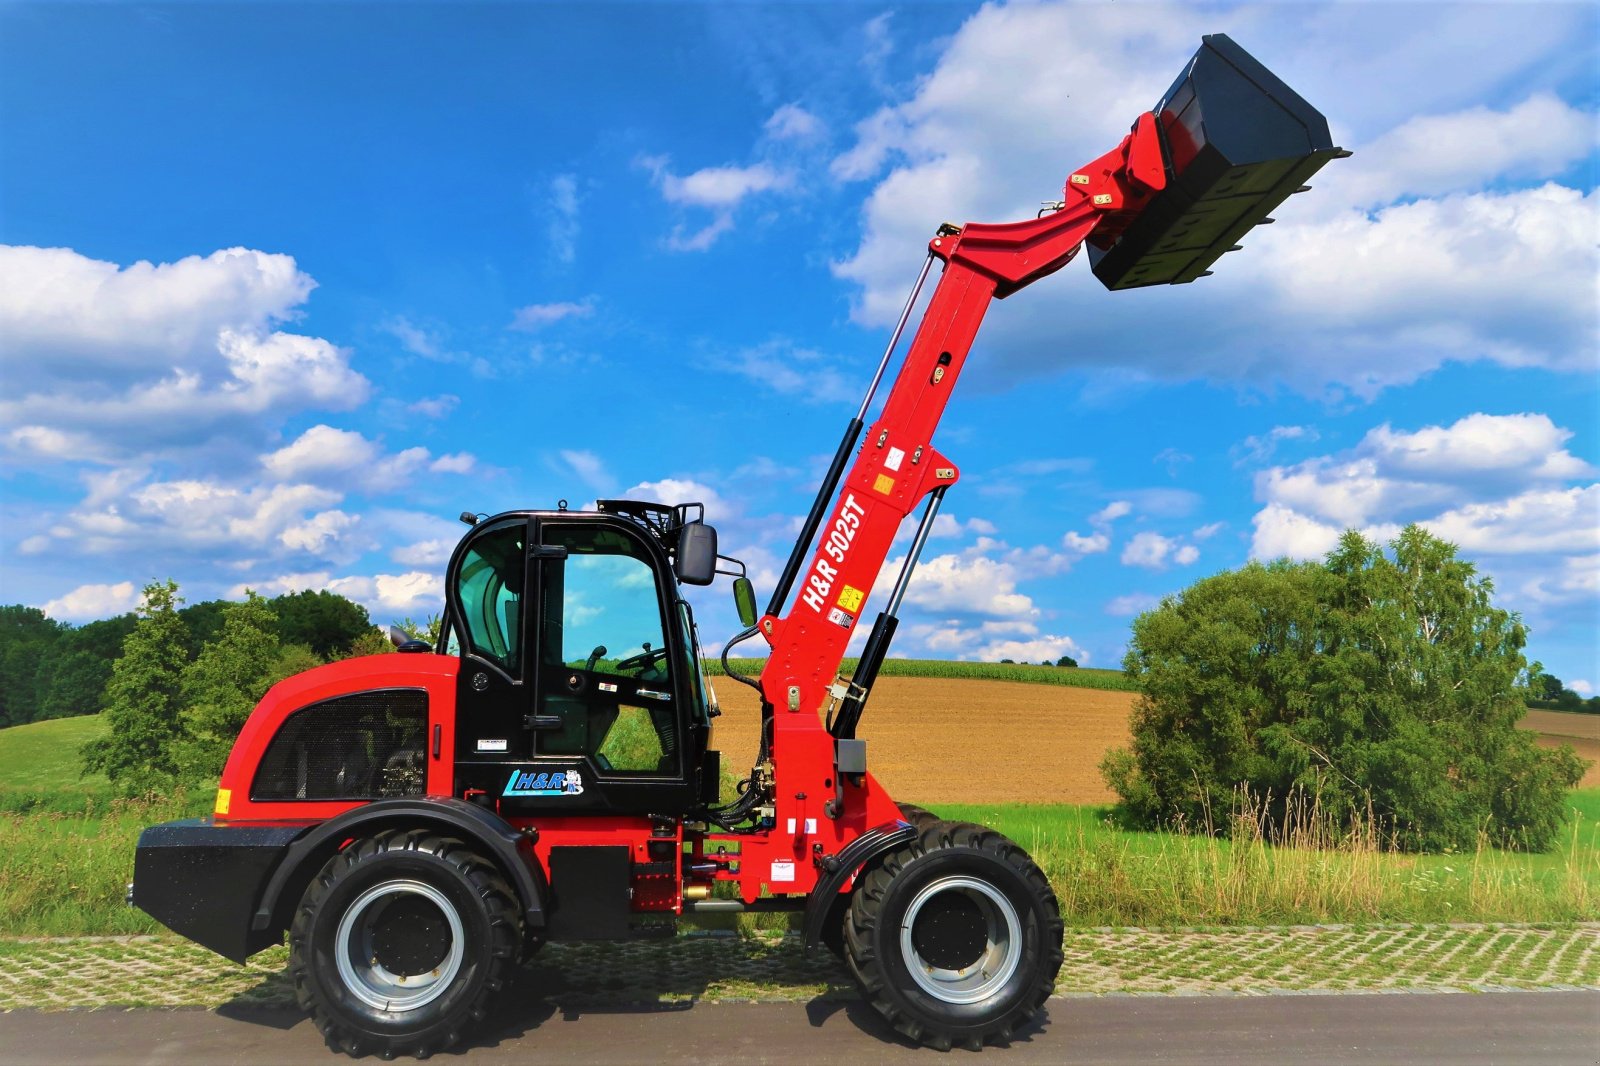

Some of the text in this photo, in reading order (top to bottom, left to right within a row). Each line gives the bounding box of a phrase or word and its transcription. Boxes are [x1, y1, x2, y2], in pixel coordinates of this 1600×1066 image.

[802, 493, 865, 613] H&R 5025T
[515, 772, 566, 789] H&R
